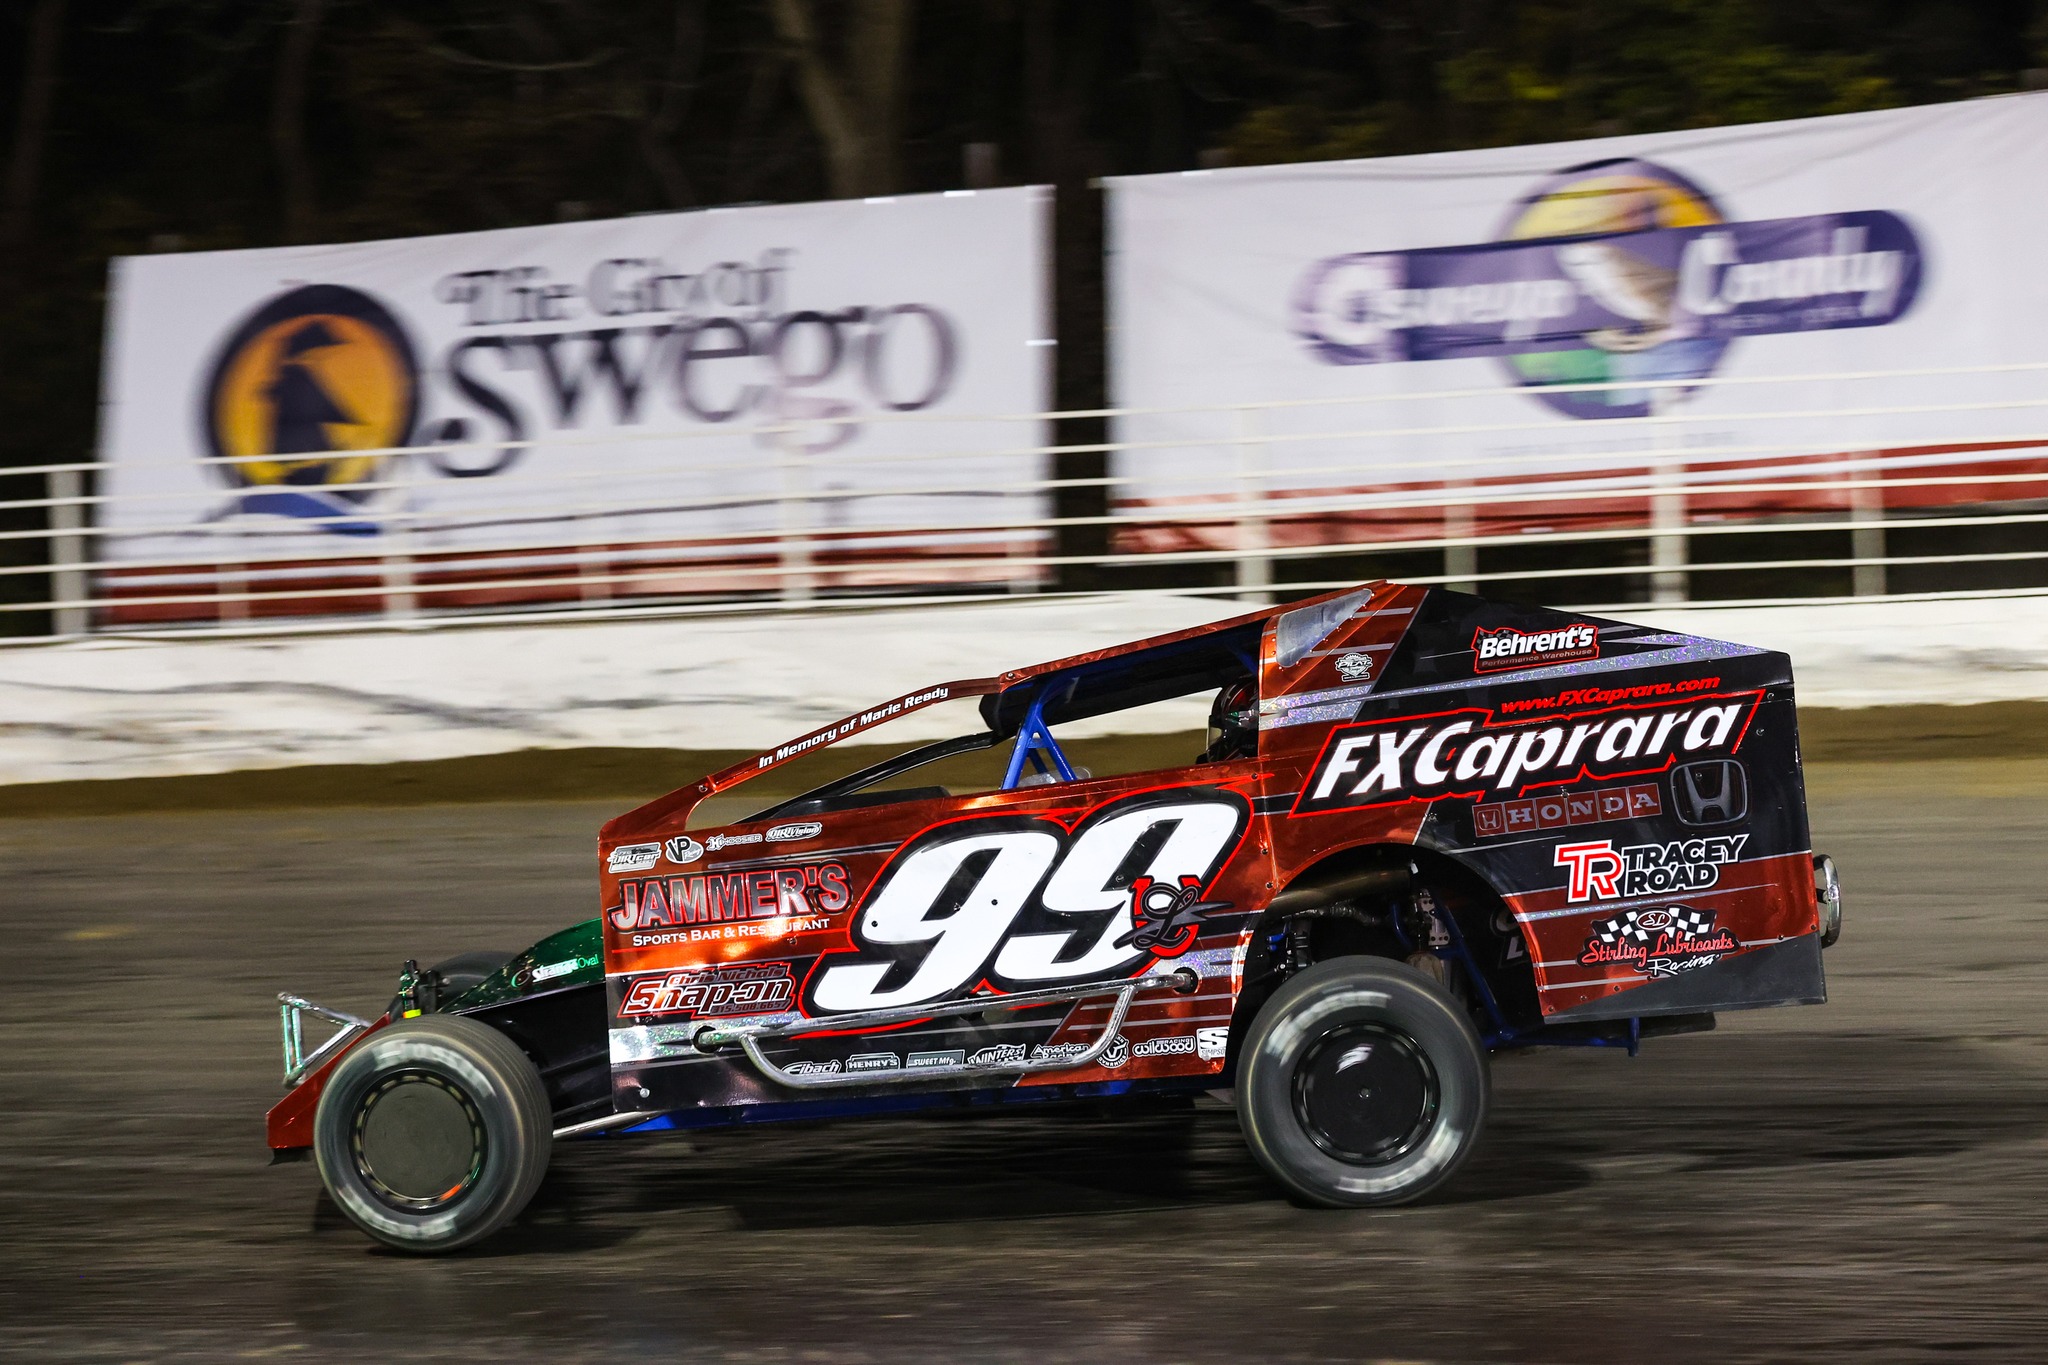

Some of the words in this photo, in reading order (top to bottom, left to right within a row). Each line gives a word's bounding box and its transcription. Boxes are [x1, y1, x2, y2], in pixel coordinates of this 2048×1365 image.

[438, 265, 576, 326] The
[1479, 625, 1595, 660] Behrent's
[1481, 655, 1539, 667] Performance
[1541, 649, 1593, 660] Warehouse
[1501, 676, 1720, 714] www.FXCaprara.com
[757, 756, 774, 769] In
[775, 728, 837, 761] Memory
[840, 717, 857, 735] of
[860, 702, 901, 727] Marie
[904, 686, 949, 709] Ready
[1313, 702, 1743, 801] FXCaprara
[1507, 793, 1658, 824] HONDA
[668, 837, 691, 862] VP
[1621, 834, 1749, 870] TRACEY
[1555, 840, 1625, 902] TR
[1625, 863, 1719, 897] ROAD
[610, 862, 852, 931] JAMMER'S
[813, 802, 1239, 1011] 99
[723, 926, 735, 938] &
[1581, 936, 1648, 966] Stirling
[1650, 930, 1735, 959] Lubricants
[667, 972, 715, 986] Chris
[718, 966, 787, 982] Nichols
[1647, 954, 1720, 976] Racing
[623, 977, 794, 1015] Snap-on
[913, 1057, 938, 1066] SWEET
[969, 1048, 1023, 1064] WINTERS
[1034, 1044, 1090, 1055] American
[1134, 1037, 1194, 1055] wilwood
[784, 1062, 840, 1075] Eibach
[849, 1057, 898, 1069] HENRY'S
